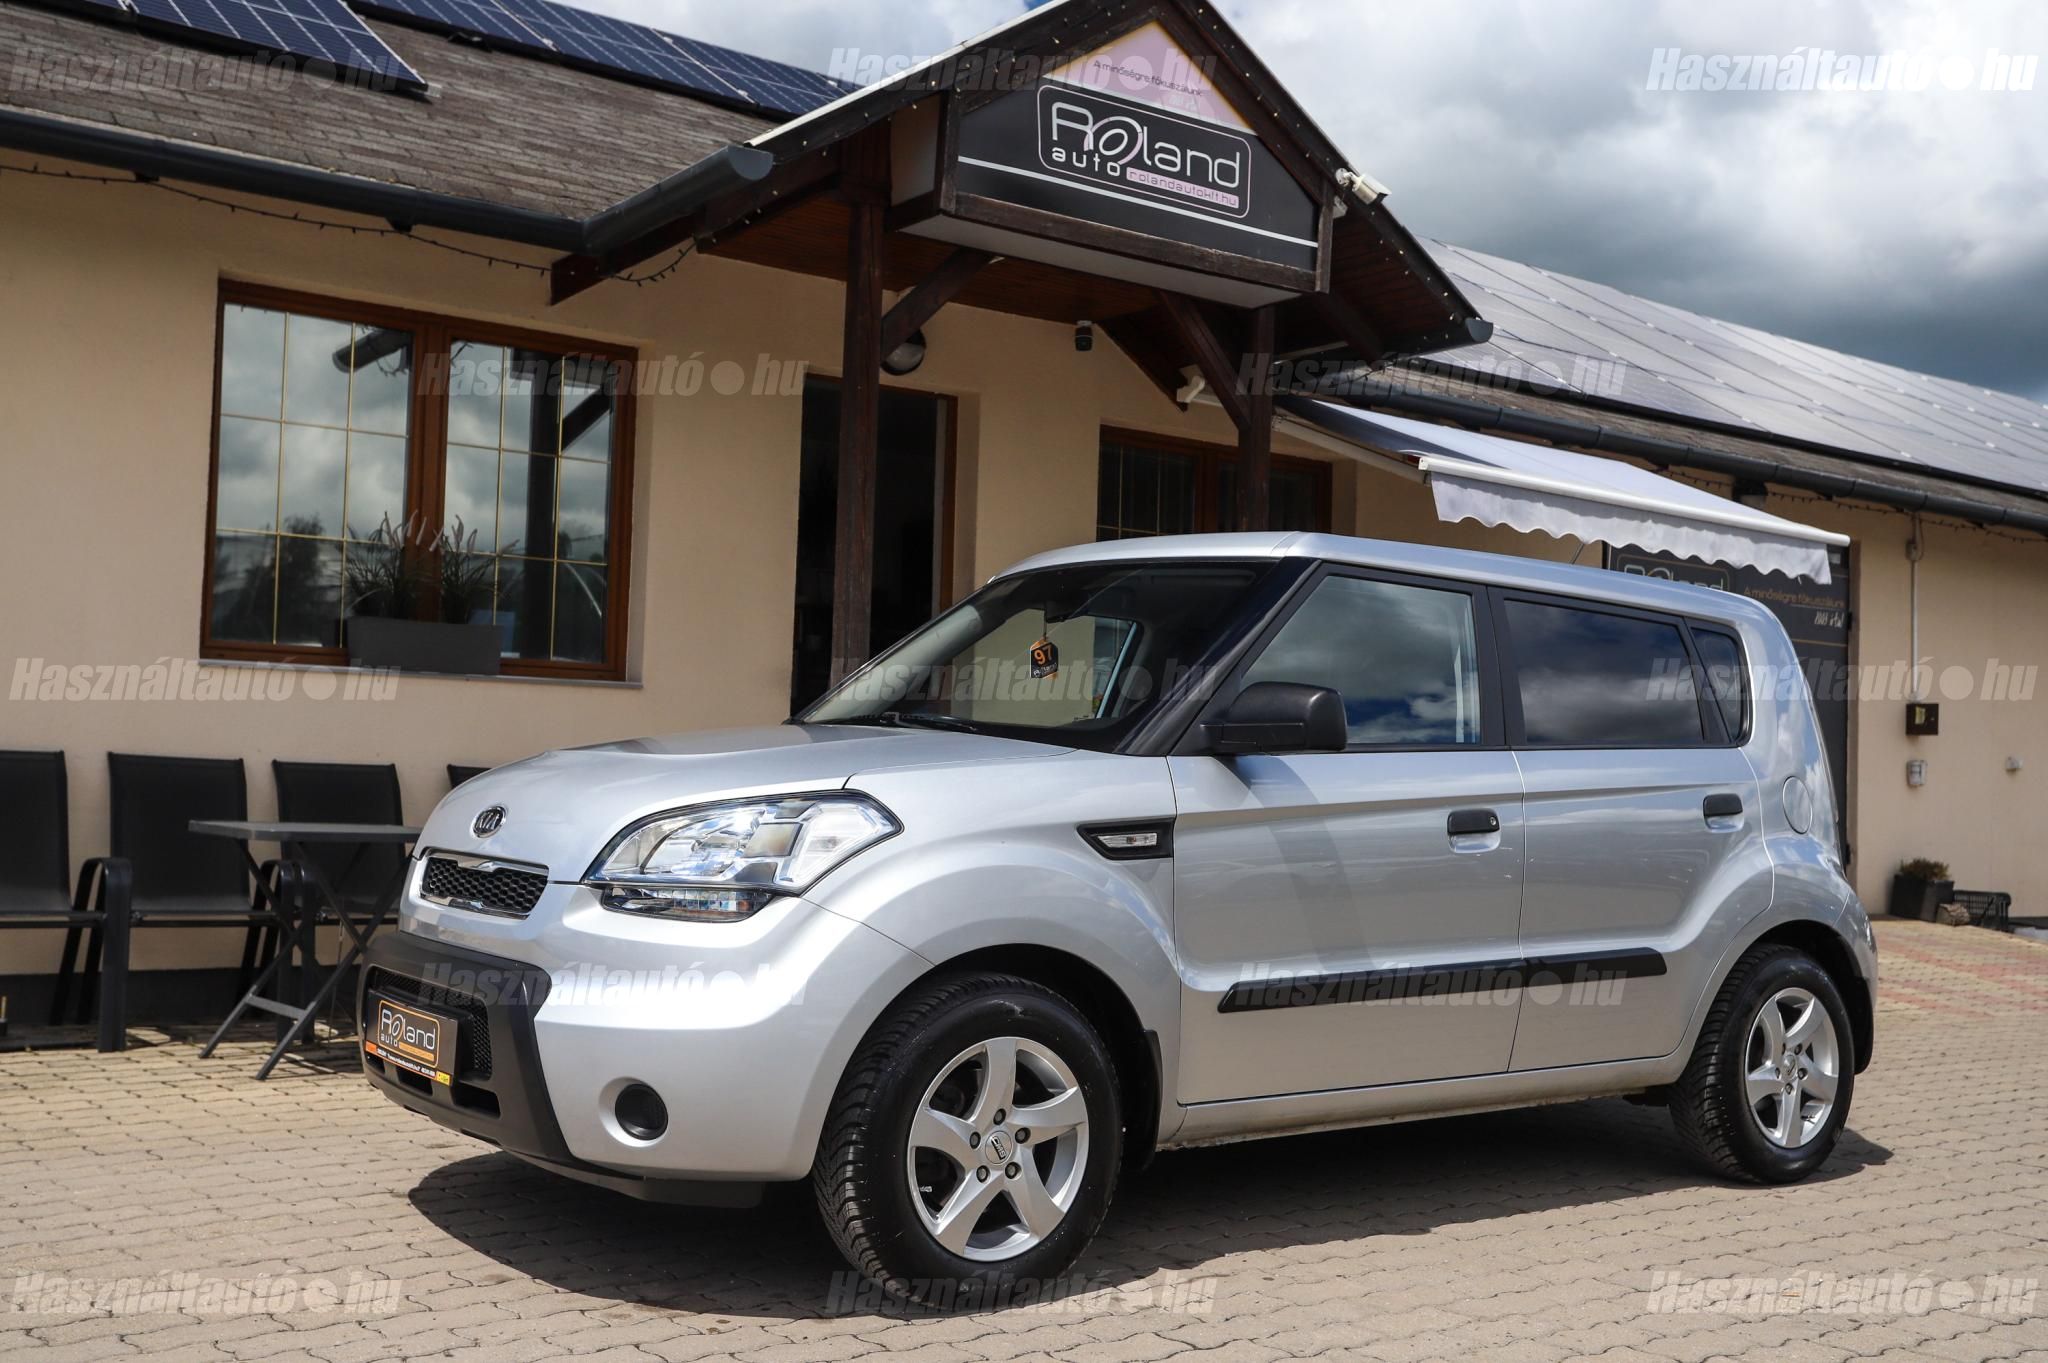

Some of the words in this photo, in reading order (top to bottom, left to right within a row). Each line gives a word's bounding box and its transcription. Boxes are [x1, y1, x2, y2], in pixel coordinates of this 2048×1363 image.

[1051, 101, 1241, 189] Roland
[1051, 147, 1121, 177] auto
[1034, 644, 1054, 665] 97
[380, 1033, 399, 1047] auto
[381, 1009, 436, 1050] Roland
